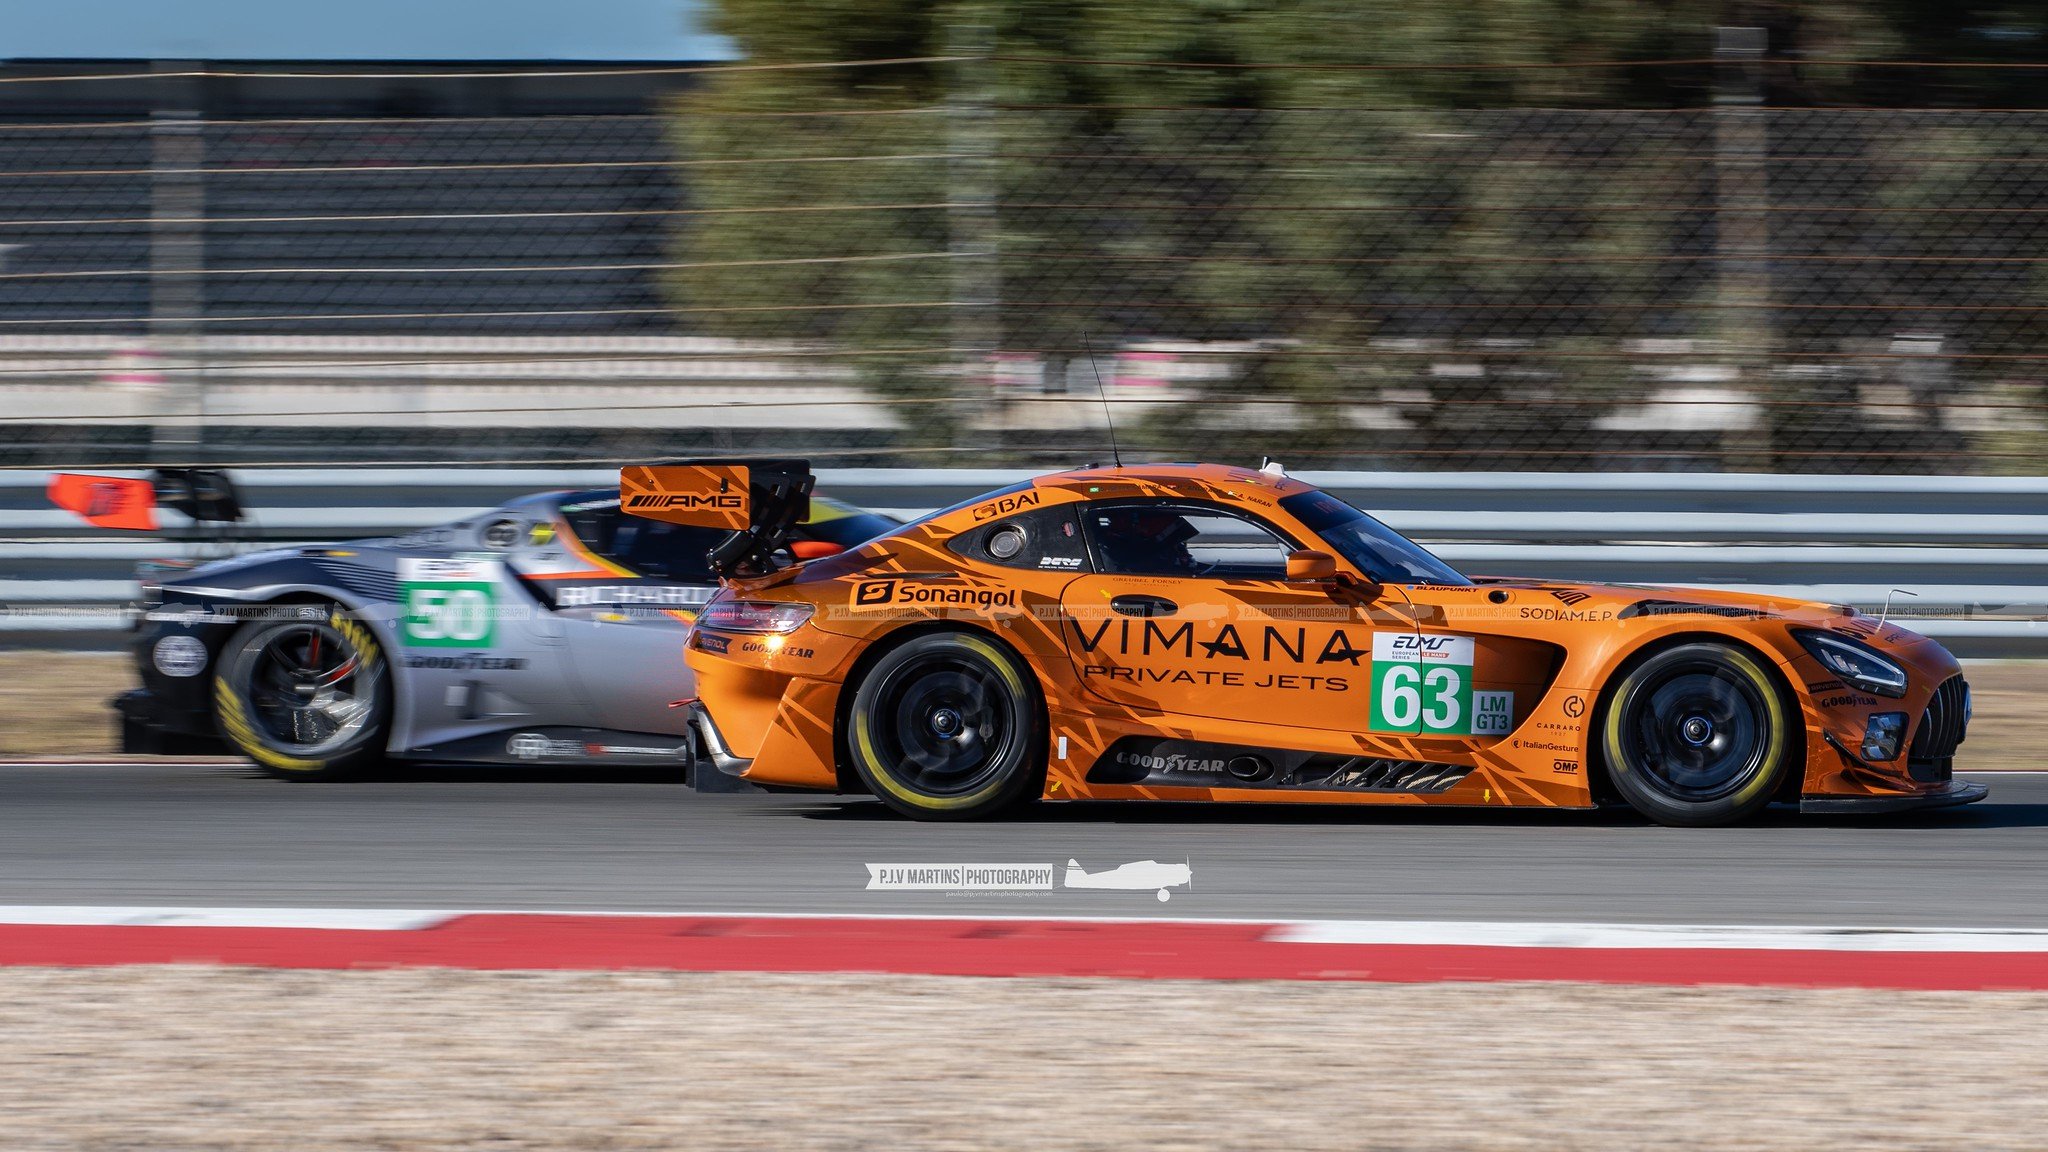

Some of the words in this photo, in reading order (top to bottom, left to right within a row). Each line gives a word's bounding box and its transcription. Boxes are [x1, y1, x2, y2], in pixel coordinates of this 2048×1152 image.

[664, 495, 742, 508] AMG
[998, 491, 1040, 514] BAI
[1247, 495, 1273, 508] NARAN
[1416, 585, 1479, 593] BLAUPUNKT
[898, 585, 1016, 611] Sonangol
[405, 588, 491, 641] 50
[1069, 615, 1371, 666] VIMANA
[742, 641, 815, 659] GOOYEAR
[1083, 664, 1244, 686] PRIVATE
[1254, 674, 1349, 692] JETS
[1381, 664, 1461, 729] 63
[1480, 695, 1507, 712] LM
[1821, 694, 1878, 708] GOODYEAR
[1476, 713, 1508, 730] GT3
[1536, 722, 1581, 731] CARRARO
[1523, 740, 1579, 752] ItalianGesture
[1116, 751, 1225, 773] GOODYEAR
[1553, 761, 1579, 772] OMP
